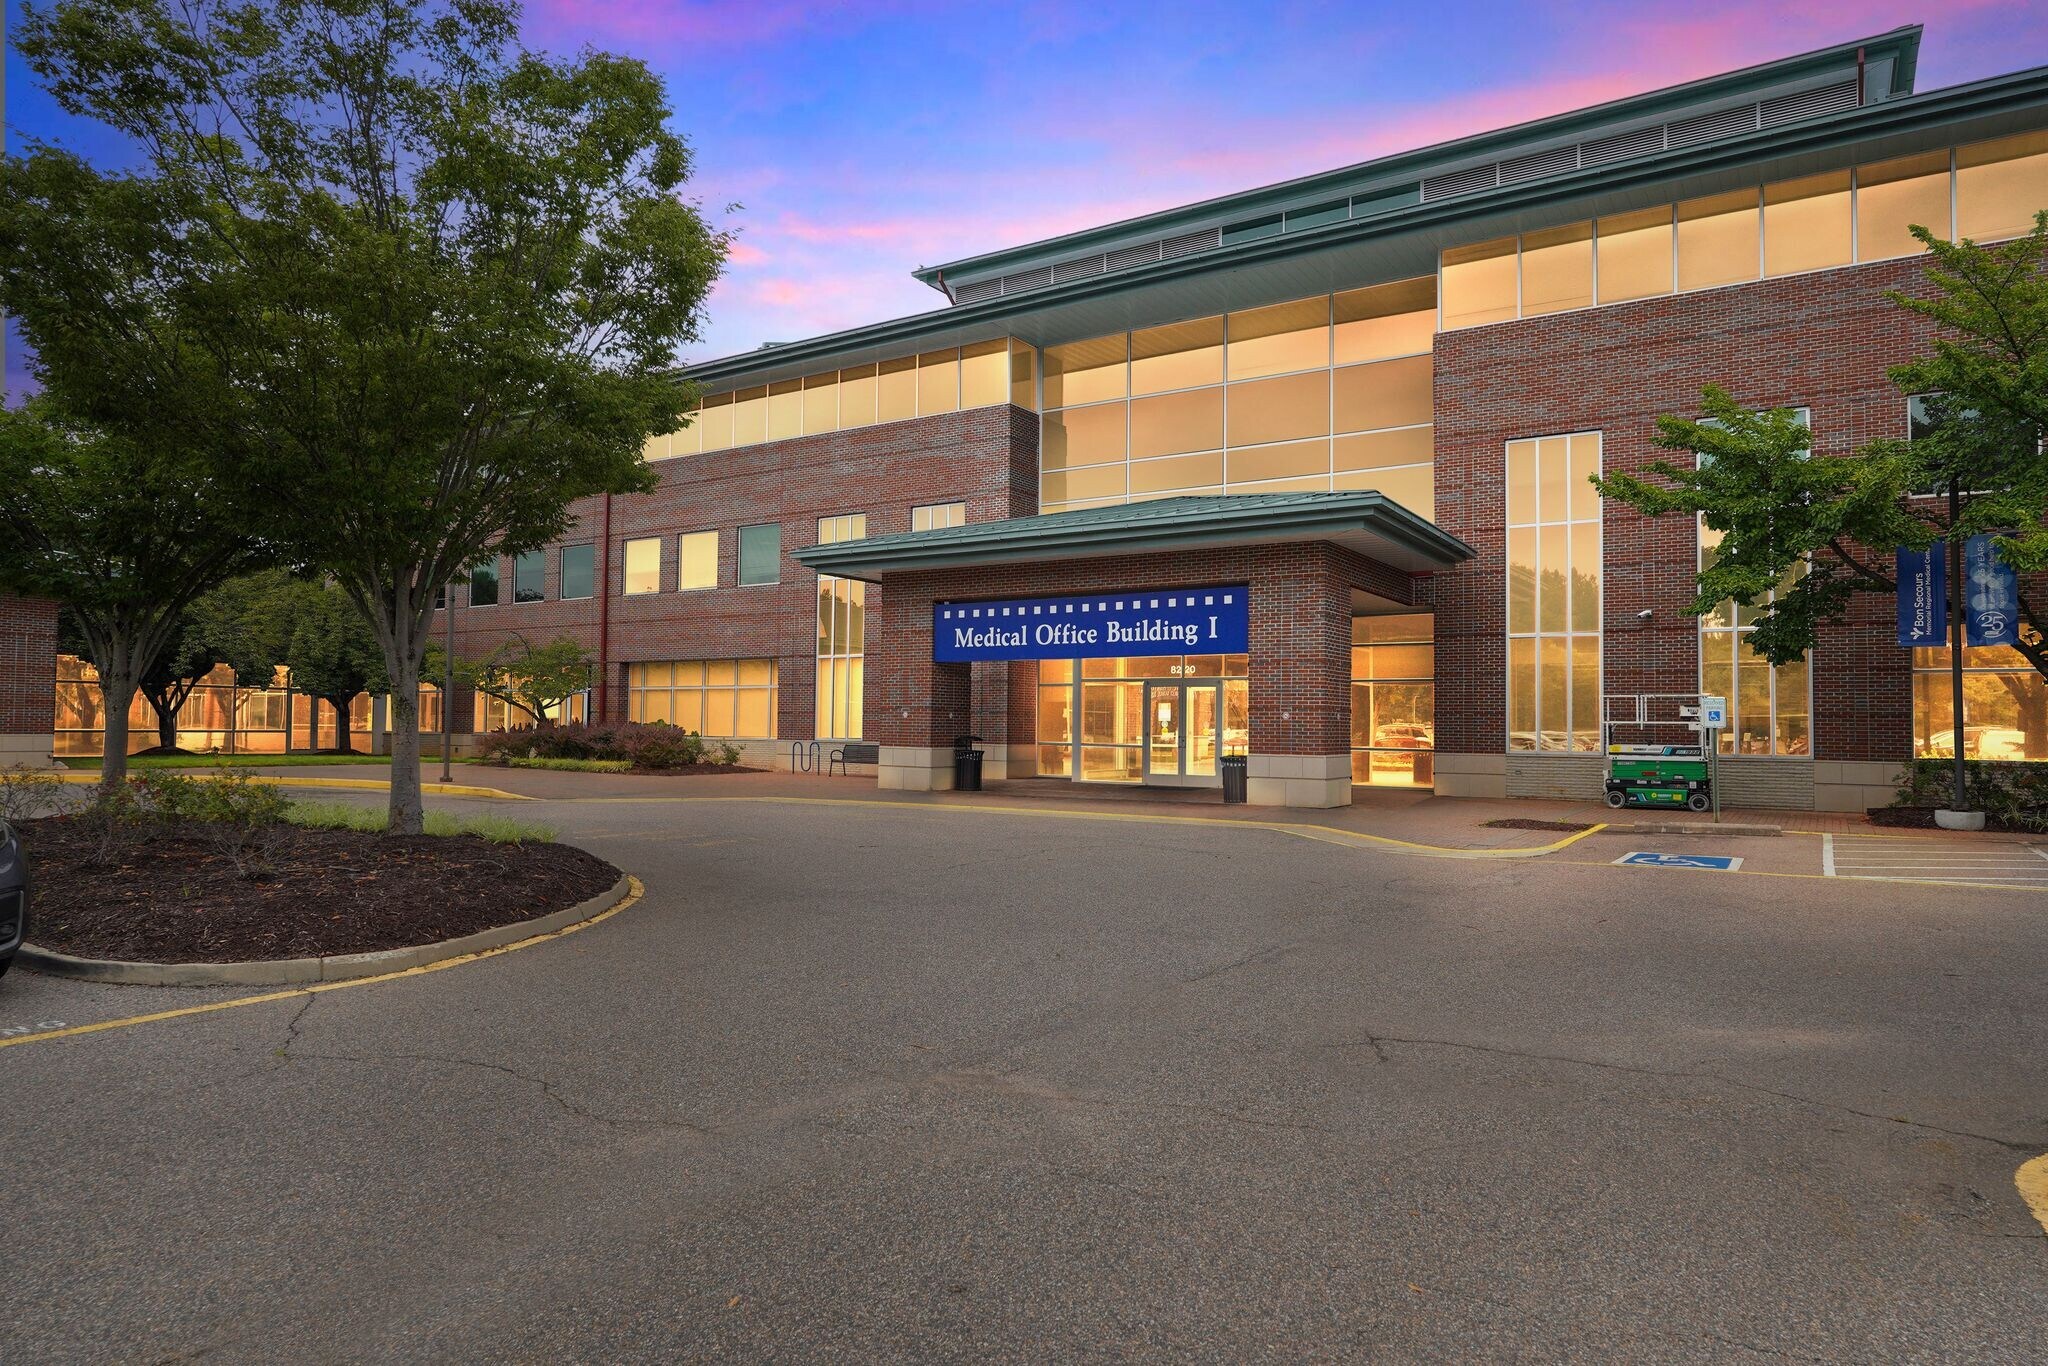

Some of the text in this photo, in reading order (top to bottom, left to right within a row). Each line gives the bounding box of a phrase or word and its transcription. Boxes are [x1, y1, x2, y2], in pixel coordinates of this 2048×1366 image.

[1977, 542, 1985, 567] YEARS
[1914, 573, 1924, 627] Bon Secours
[954, 616, 1218, 648] Medical Office Building I
[1981, 615, 2004, 631] 25
